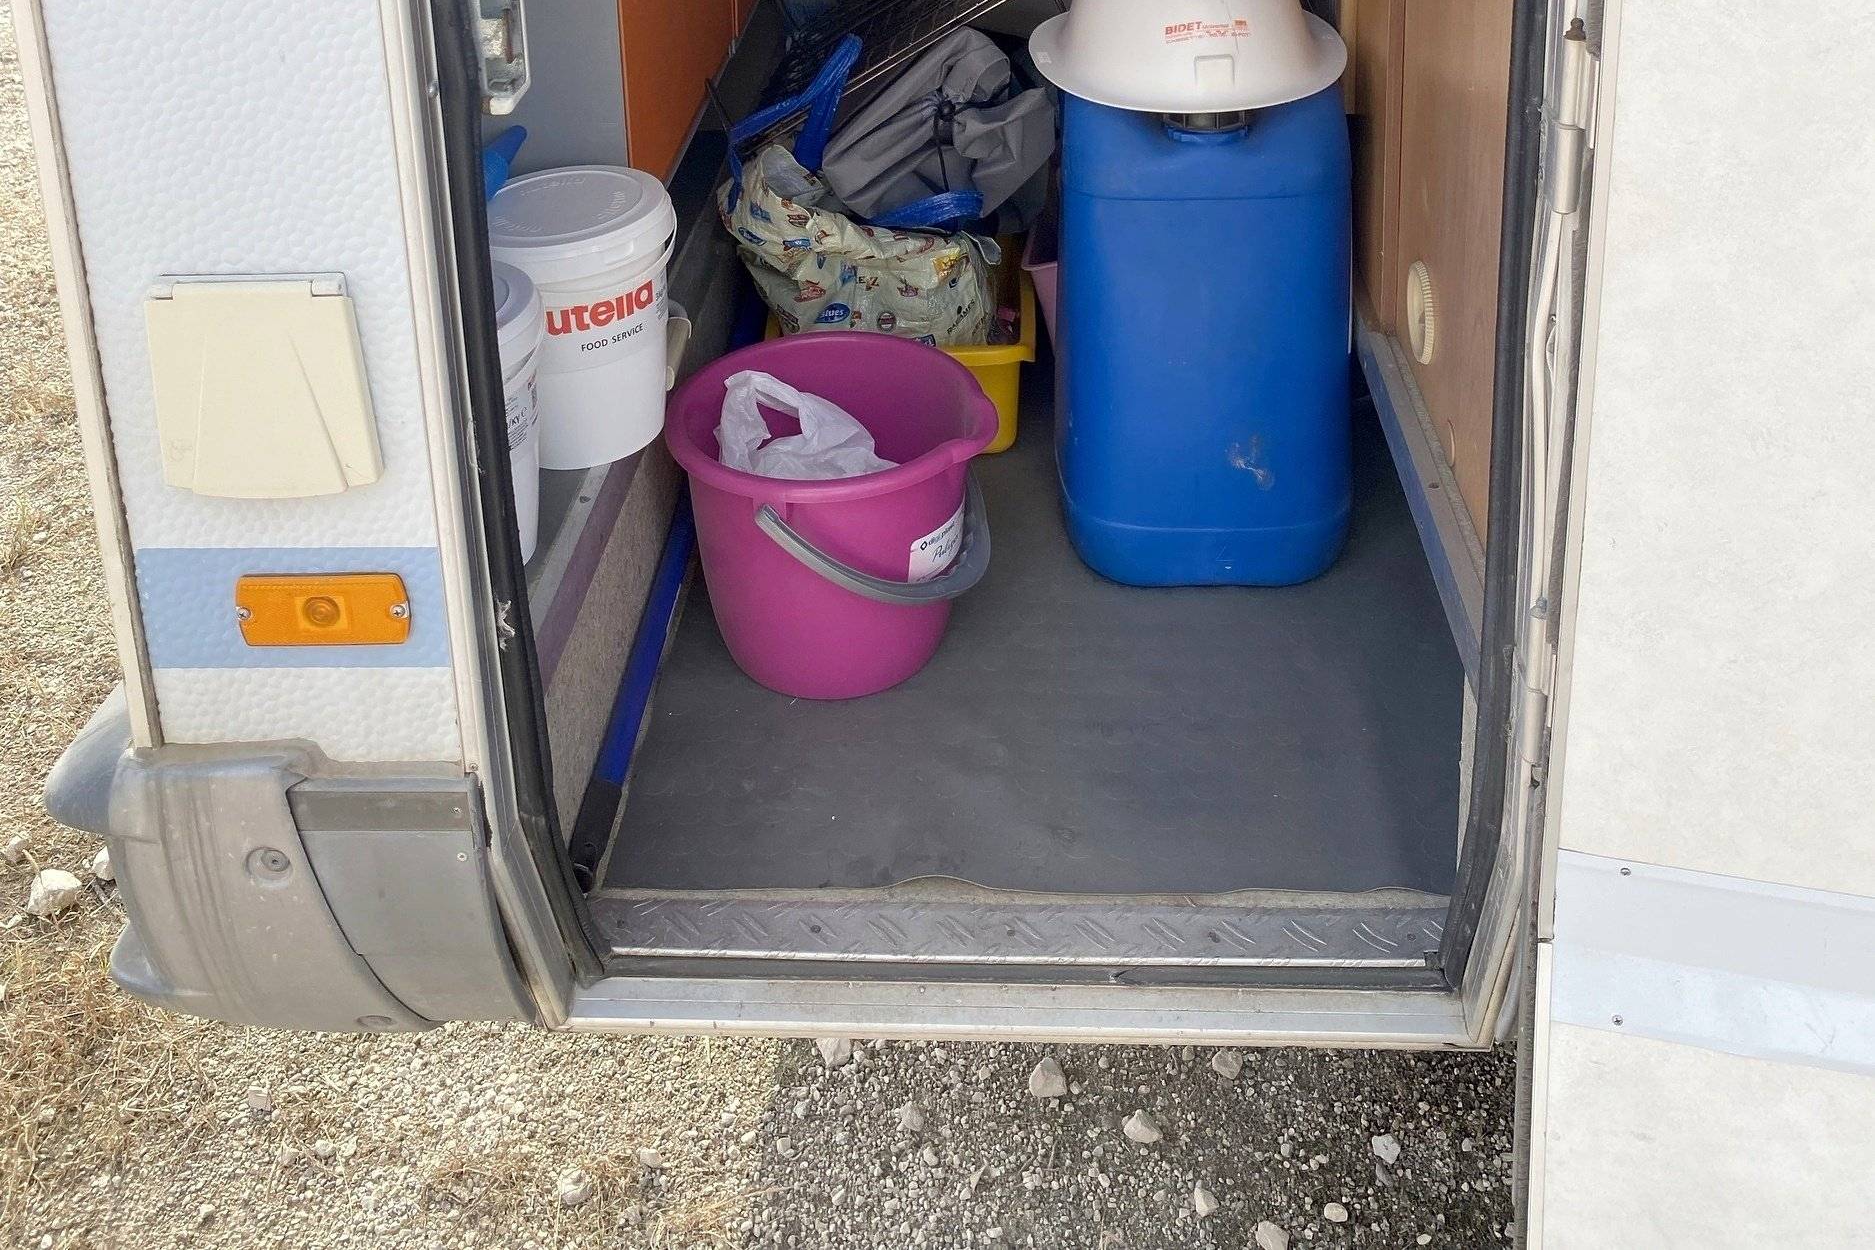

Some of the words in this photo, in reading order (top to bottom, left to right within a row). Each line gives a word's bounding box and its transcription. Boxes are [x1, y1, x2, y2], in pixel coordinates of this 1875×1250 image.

[1165, 21, 1202, 35] BIDET
[545, 278, 654, 336] utella
[581, 338, 609, 352] FOOD
[611, 323, 644, 344] SERVICE
